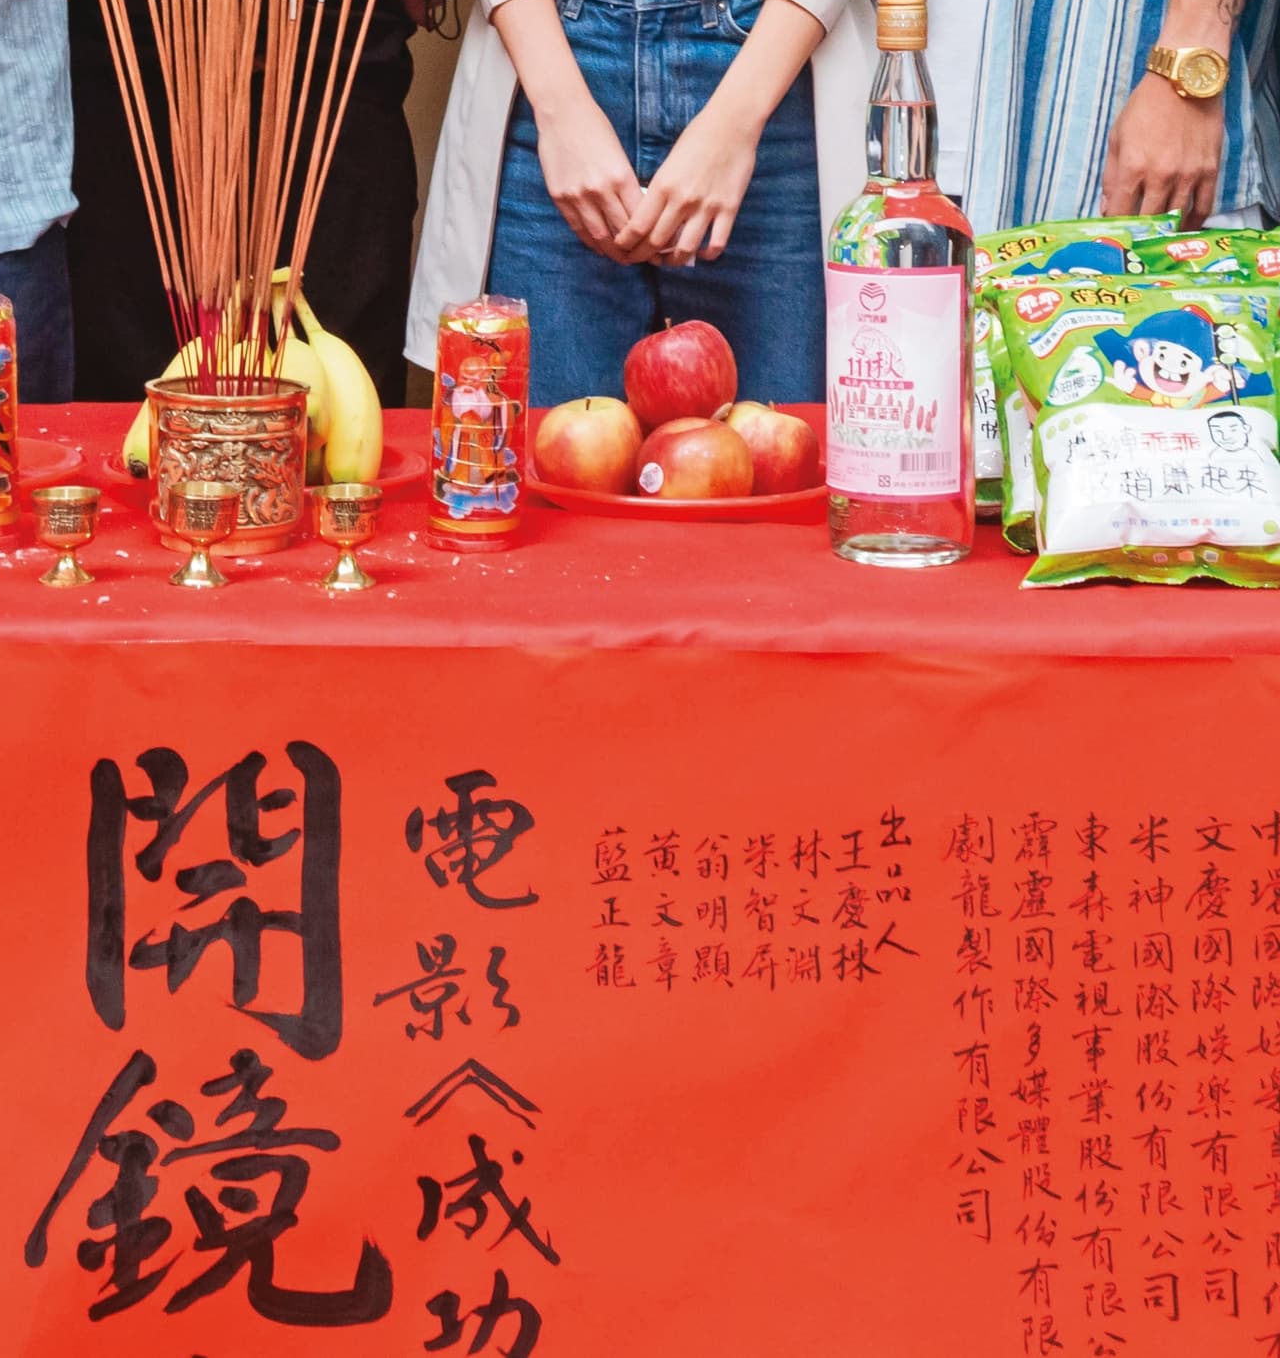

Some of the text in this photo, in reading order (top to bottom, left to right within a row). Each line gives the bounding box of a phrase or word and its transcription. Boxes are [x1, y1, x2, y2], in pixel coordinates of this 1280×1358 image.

[847, 350, 903, 379] 111秋
[1017, 291, 1061, 315] 乖乖
[586, 826, 636, 987] 藍正龍
[875, 807, 918, 955] 出品人
[24, 740, 395, 1328] 開鏡
